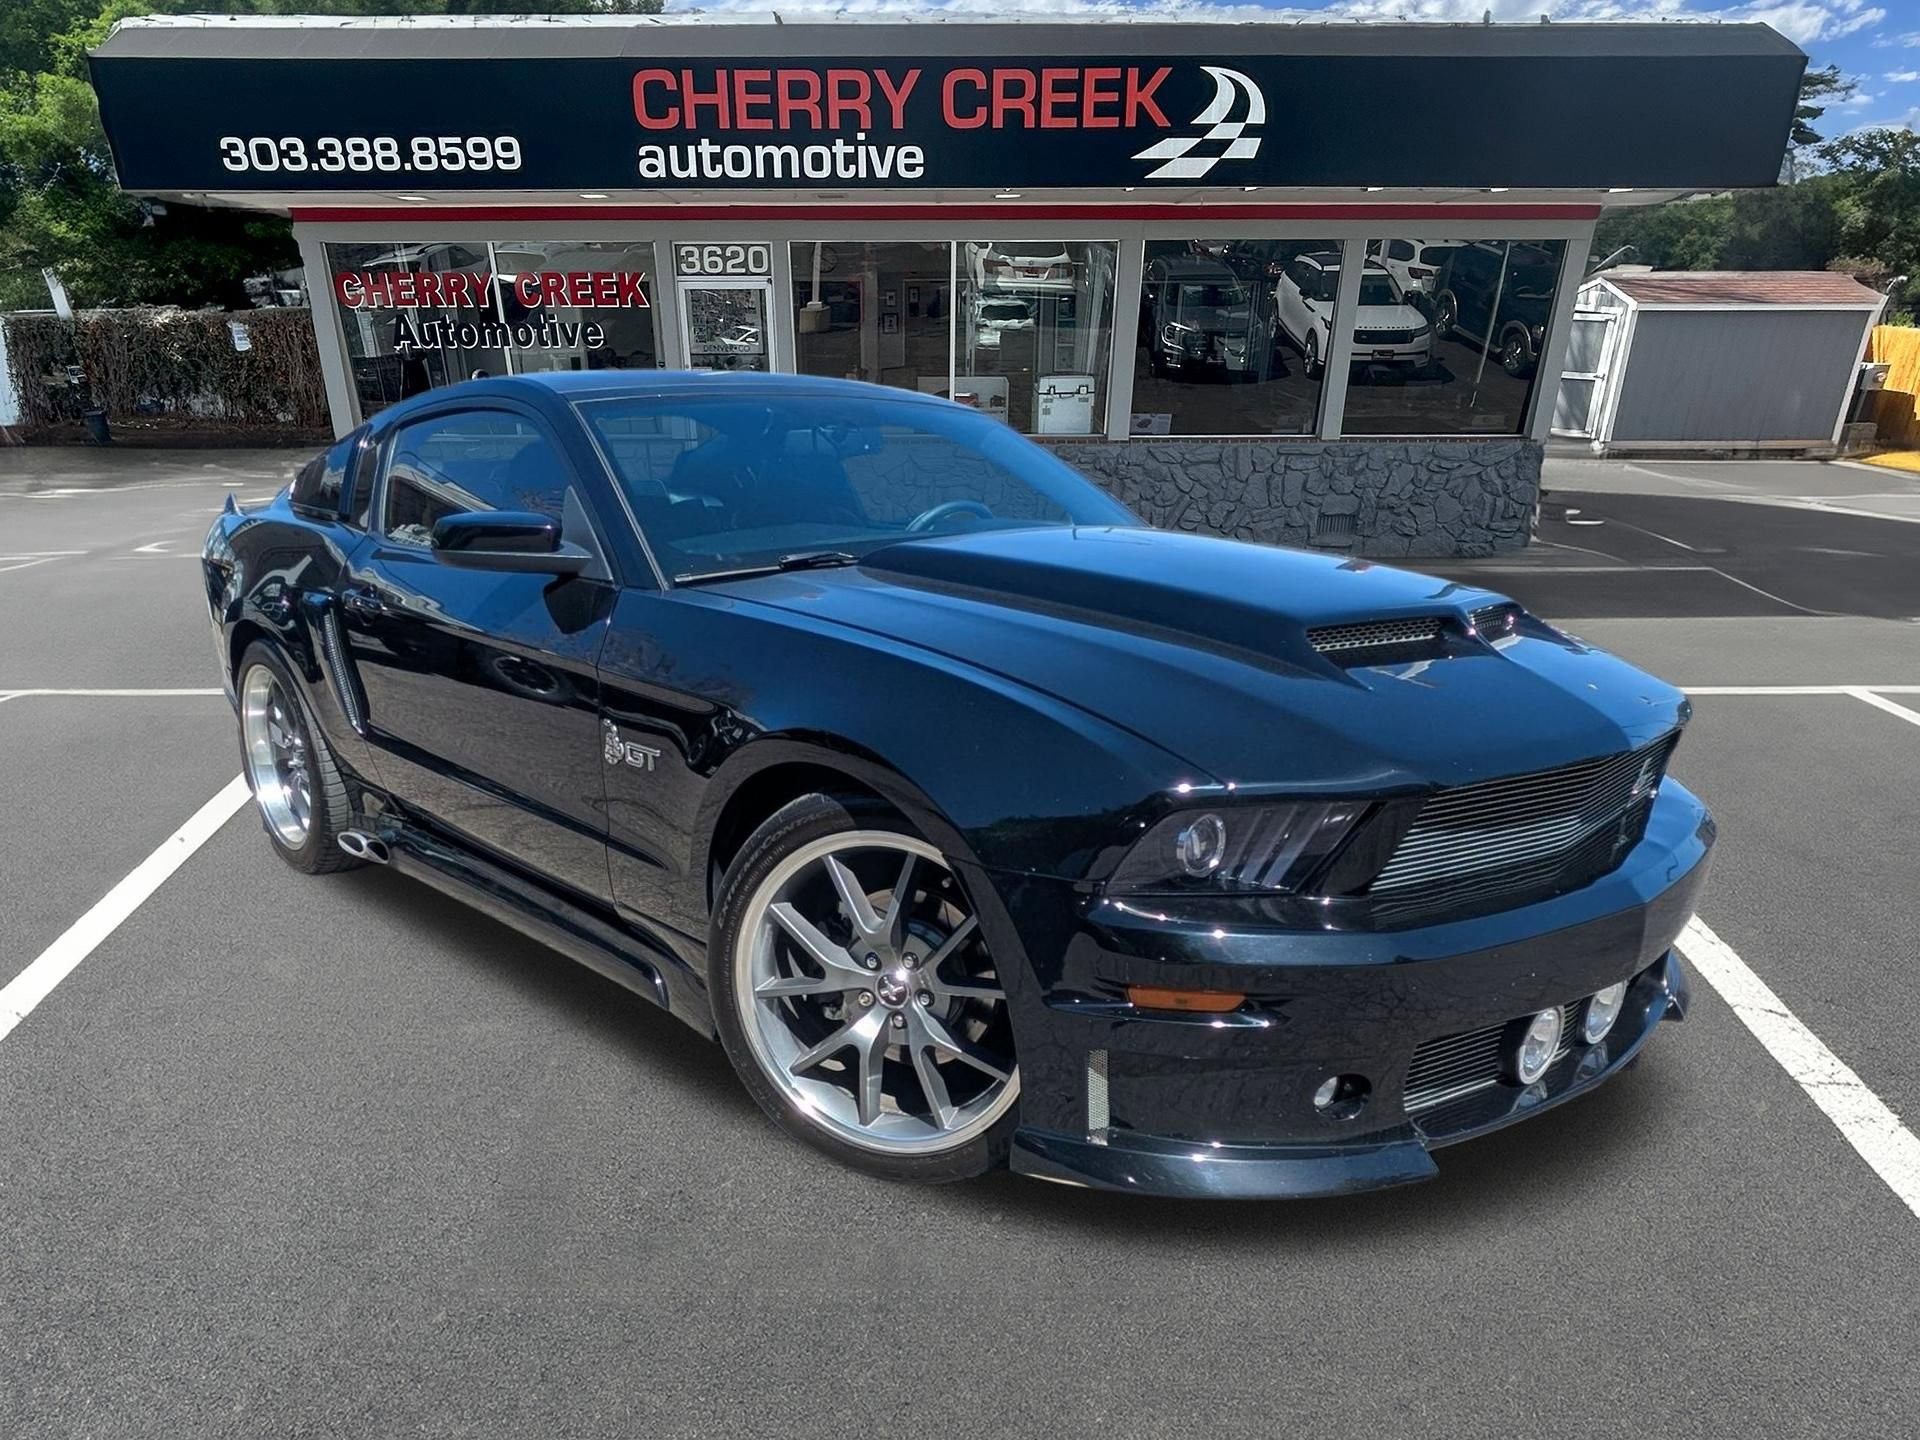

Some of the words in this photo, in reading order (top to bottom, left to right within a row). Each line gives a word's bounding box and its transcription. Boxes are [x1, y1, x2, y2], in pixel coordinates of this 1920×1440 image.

[631, 68, 922, 130] CHERRY
[942, 67, 1173, 129] CREEK
[219, 136, 522, 172] 303.388.8599
[638, 132, 925, 180] automotive
[680, 245, 769, 274] 3620
[335, 271, 494, 309] CHERRY
[514, 271, 651, 309] CREEK
[393, 313, 606, 350] Automotive
[624, 741, 661, 772] GT
